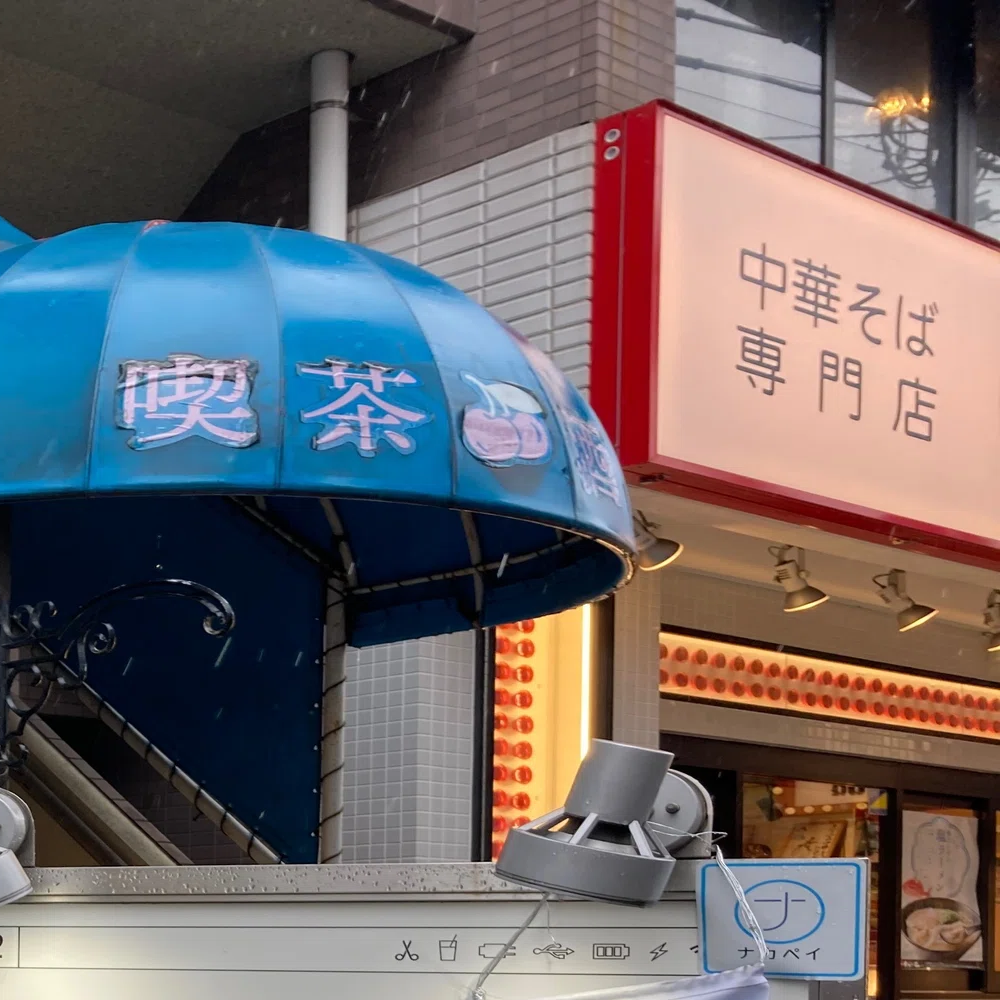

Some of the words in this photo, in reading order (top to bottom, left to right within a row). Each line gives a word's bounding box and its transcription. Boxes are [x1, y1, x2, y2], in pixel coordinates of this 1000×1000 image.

[739, 242, 939, 357] 中華そば
[735, 326, 938, 442] 専門店
